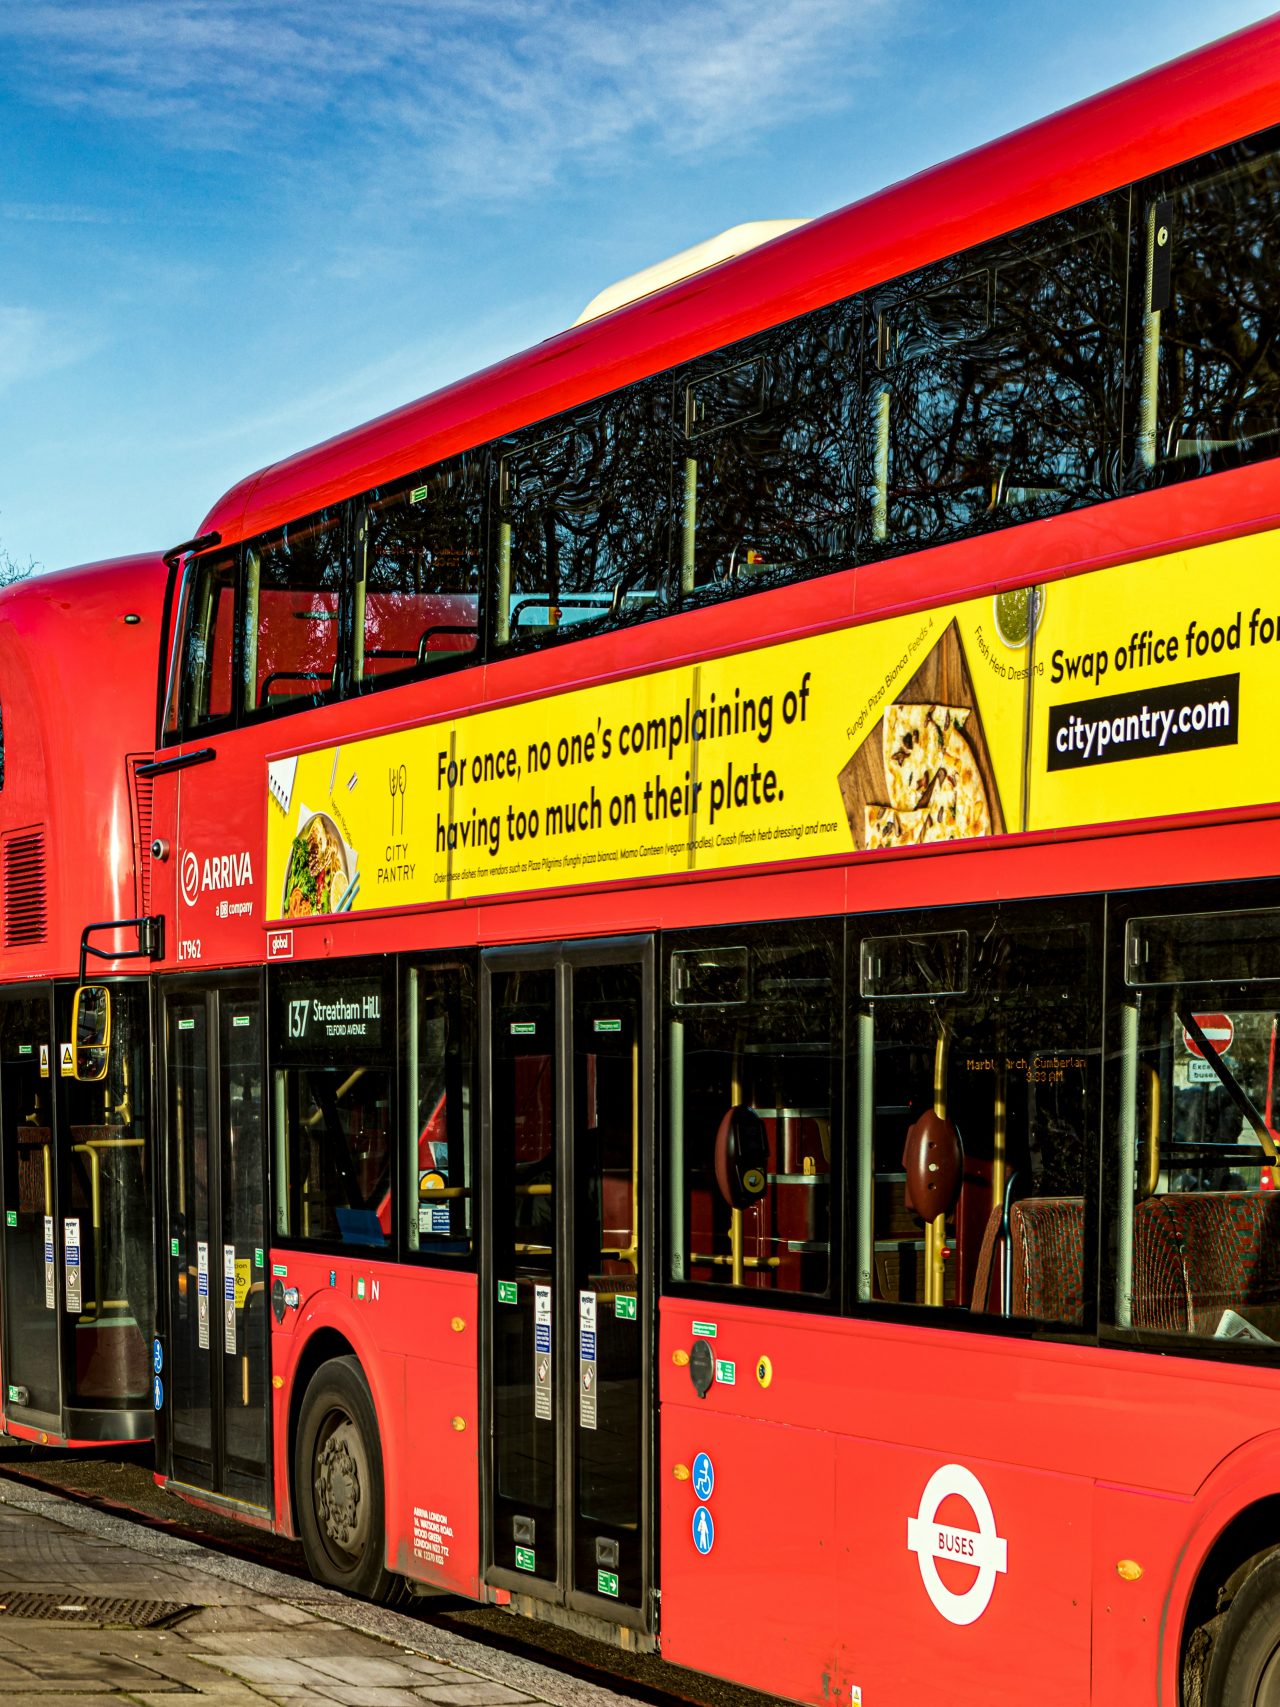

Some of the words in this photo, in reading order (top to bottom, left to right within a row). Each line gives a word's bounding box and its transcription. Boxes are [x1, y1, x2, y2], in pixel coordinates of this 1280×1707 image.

[974, 625, 991, 663] Fresh
[988, 653, 1006, 678] Herb
[1050, 649, 1108, 686] Swap
[1114, 630, 1179, 672] office
[1186, 611, 1242, 658] food
[846, 709, 869, 740] Funghi
[867, 685, 886, 712] Pizza
[884, 654, 910, 688] Bianca
[907, 628, 929, 657] Feeds
[437, 751, 467, 790] For
[471, 748, 521, 783] once,
[527, 741, 551, 773] no
[557, 716, 613, 768] one’s
[618, 687, 773, 760] complaining
[782, 672, 812, 724] of
[1056, 699, 1230, 758] citypantry.com
[436, 807, 501, 857] having
[507, 805, 539, 842] too
[546, 786, 602, 836] much
[609, 793, 637, 826] on
[643, 770, 702, 821] their
[709, 762, 785, 825] plate.
[385, 843, 409, 862] CITY
[620, 848, 638, 860] Momo
[804, 821, 819, 835] and
[819, 821, 838, 833] more
[201, 851, 254, 892] ARRIVA
[377, 864, 416, 884] PANTRY
[229, 901, 253, 917] company
[178, 939, 201, 960] LT962
[272, 934, 288, 955] global
[288, 1000, 310, 1037] 137
[312, 998, 361, 1022] Streatham
[361, 995, 381, 1019] Hill
[326, 1025, 347, 1036] TELFORD
[347, 1023, 367, 1036] AVENUE
[966, 1059, 996, 1070] Marbl
[1033, 1057, 1086, 1069] Cumberlan
[1048, 1071, 1064, 1082] AM
[372, 1279, 380, 1301] N
[939, 1532, 975, 1557] BUSES
